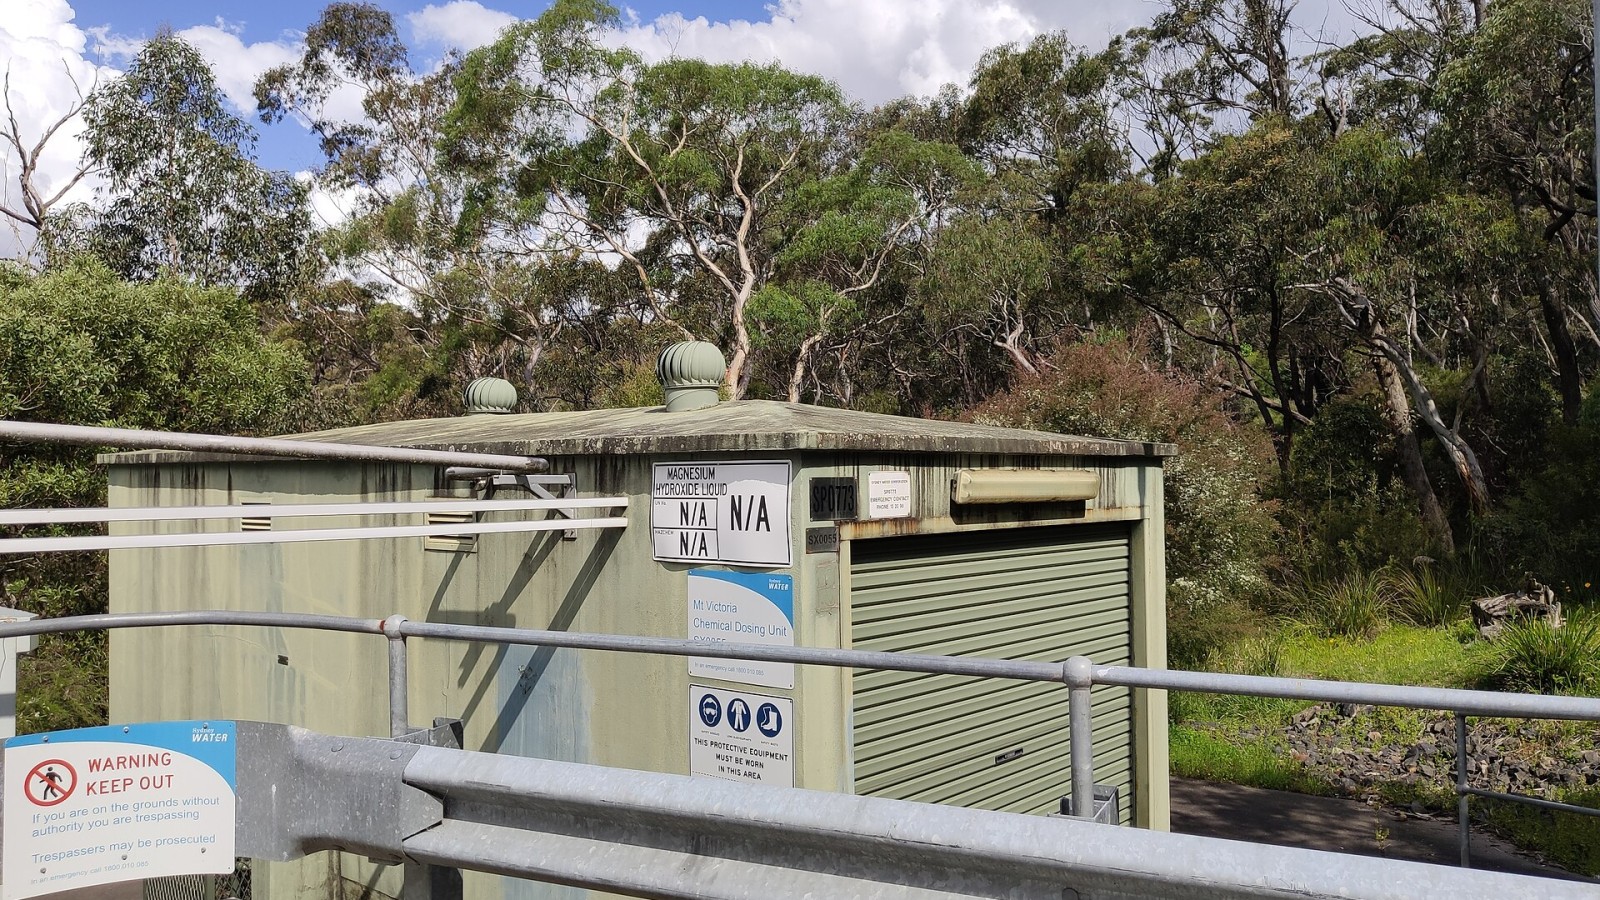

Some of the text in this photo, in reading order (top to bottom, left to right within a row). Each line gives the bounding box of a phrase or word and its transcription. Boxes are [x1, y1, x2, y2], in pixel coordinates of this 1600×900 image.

[667, 467, 716, 480] MAGNESIUM
[656, 483, 728, 496] HYDROXIDE LIQUID
[813, 484, 855, 513] SP0773
[680, 502, 708, 526] N/A
[730, 494, 771, 532] N/A
[680, 532, 708, 556] N/A
[808, 534, 836, 545] SX0055
[693, 600, 737, 613] Mt Victoria
[693, 618, 787, 637] Chemical Dosing Unit
[192, 733, 228, 742] WATER
[694, 738, 708, 746] THIS
[710, 740, 748, 754] PROTECTIVE
[750, 748, 788, 762] EQUIPMENT
[88, 752, 172, 772] WARNING
[716, 754, 764, 768] MUST BE WORN
[727, 767, 741, 776] THIS
[743, 771, 762, 780] AREA
[86, 774, 174, 796] KEEP OUT
[32, 814, 40, 823] If
[44, 812, 65, 824] you
[70, 808, 88, 817] are
[111, 803, 129, 812] the
[132, 798, 178, 812] grounds
[182, 797, 219, 806] without
[32, 810, 199, 837] authority you are trespassing
[32, 834, 215, 864] Trespassers may be prosecuted
[50, 870, 89, 881] emergency
